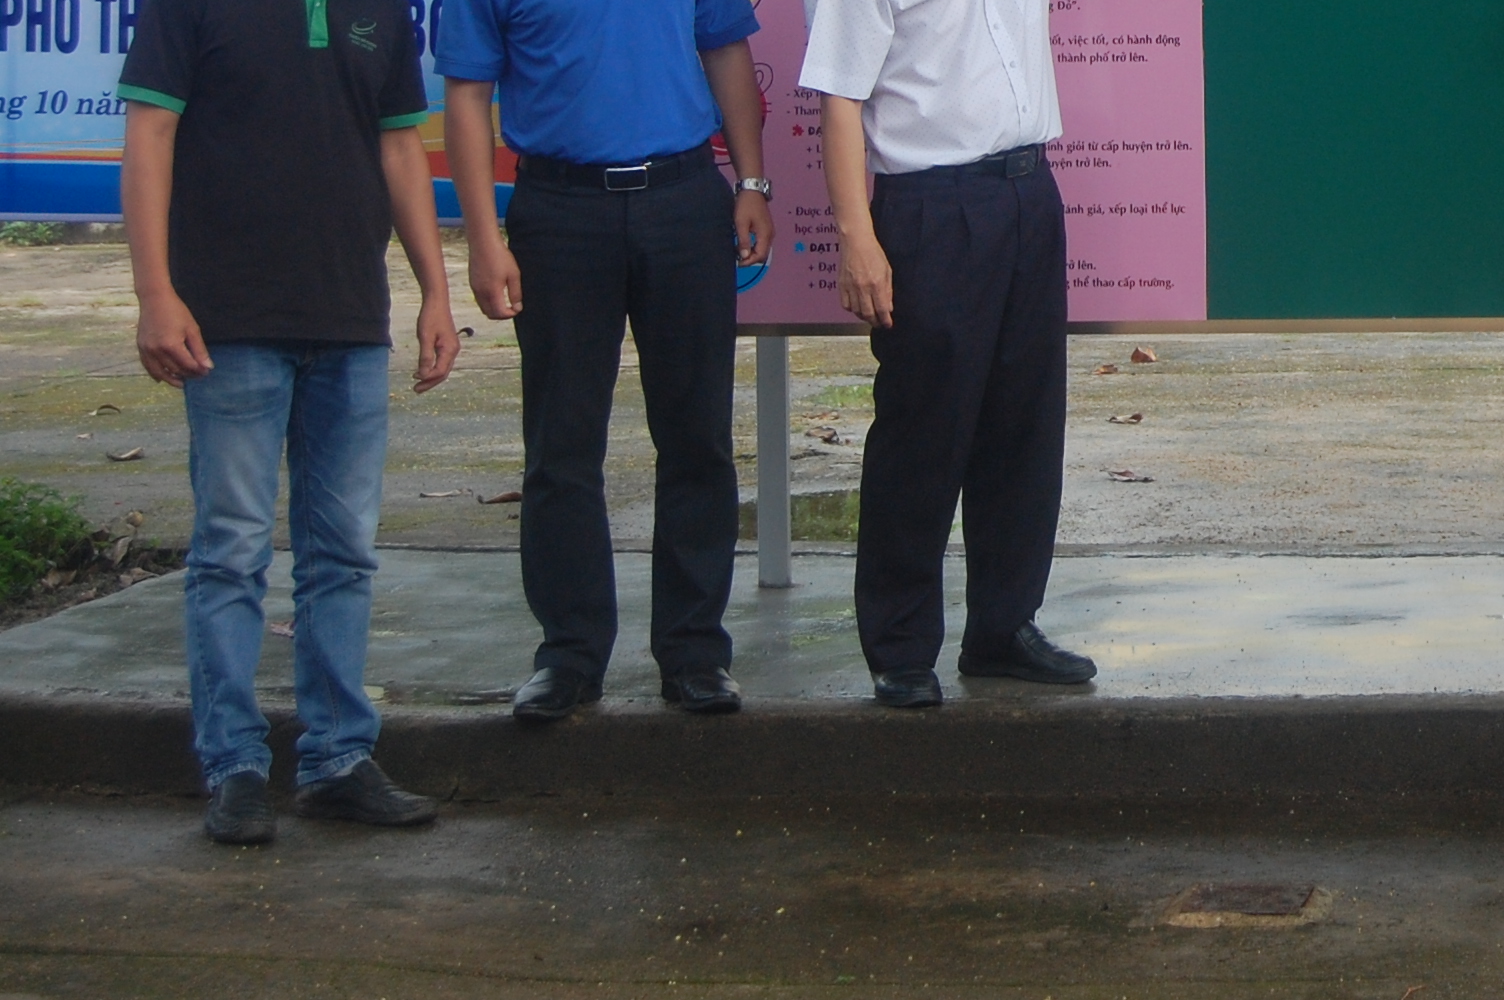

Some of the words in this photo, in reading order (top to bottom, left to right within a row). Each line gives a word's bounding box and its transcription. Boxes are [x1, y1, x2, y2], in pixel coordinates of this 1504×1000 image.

[1068, 34, 1088, 47] việc
[1092, 33, 1109, 47] tốt,
[1112, 34, 1124, 45] có
[1127, 34, 1152, 45] hành
[1155, 34, 1181, 47] động
[1057, 52, 1086, 63] thành
[1089, 50, 1111, 65] phố
[1112, 52, 1127, 63] trở
[1129, 52, 1148, 63] lên.
[34, 90, 69, 115] 10
[1046, 141, 1064, 151] inh
[1066, 141, 1085, 154] giỏi
[1088, 141, 1099, 151] từ
[1101, 140, 1119, 154] cấp
[1122, 141, 1153, 154] huyện
[1156, 140, 1171, 151] trở
[1173, 140, 1193, 151] lên.
[1075, 156, 1091, 168] trở
[1093, 157, 1112, 168] lên.
[795, 206, 821, 218] Được
[1063, 204, 1084, 214] ánh
[1087, 204, 1105, 217] giá,
[1108, 202, 1127, 217] xếp
[1129, 203, 1148, 216] loại
[1151, 202, 1168, 214] thể
[1171, 203, 1186, 216] lực
[794, 223, 813, 236] học
[815, 223, 839, 235] sinh,
[809, 243, 831, 254] ĐẠT
[818, 262, 837, 273] Đạt
[1077, 259, 1097, 270] lên.
[818, 279, 837, 291] Đạt
[1073, 275, 1090, 288] thể
[1092, 277, 1115, 288] thao
[1117, 275, 1136, 290] cấp
